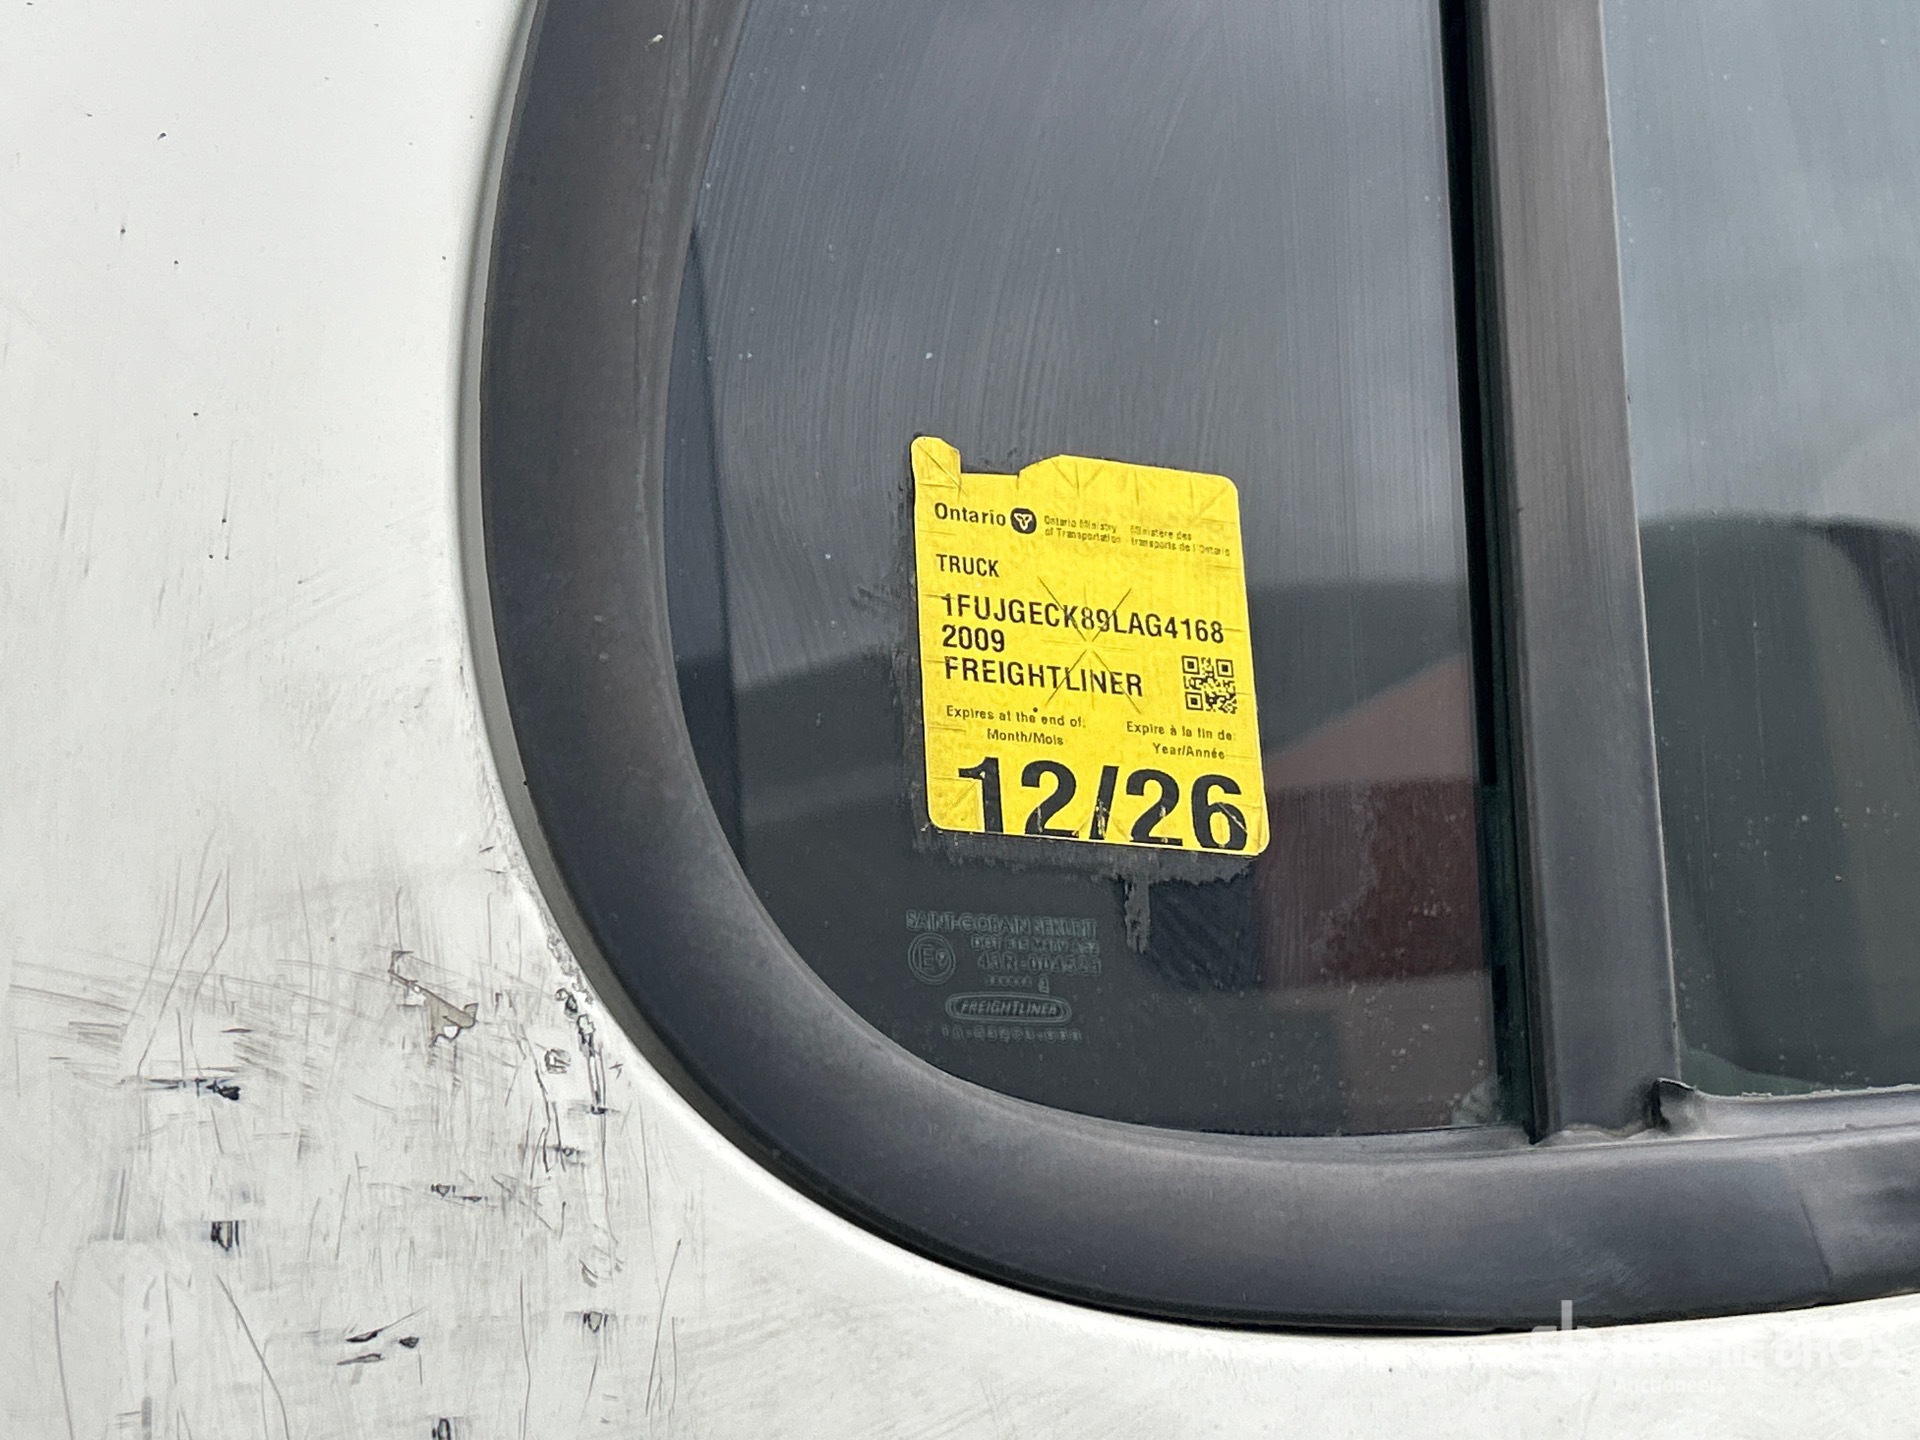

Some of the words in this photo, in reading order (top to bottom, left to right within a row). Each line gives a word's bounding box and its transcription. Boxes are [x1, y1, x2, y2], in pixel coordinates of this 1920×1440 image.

[934, 502, 1006, 526] Ontario
[936, 553, 1000, 578] TRUCK
[940, 593, 1225, 643] 1FUJGECK89LAG4168
[942, 624, 1006, 652] 2009
[944, 656, 1143, 697] FREIGHTLINER
[946, 705, 995, 721] Expires
[999, 709, 1013, 721] at
[1016, 710, 1037, 723] the
[1041, 712, 1065, 727] end
[987, 728, 1064, 746] Month/Mois
[1126, 721, 1166, 738] Expire
[1170, 724, 1178, 737] à
[1181, 725, 1193, 738] la
[1197, 726, 1214, 740] fin
[1152, 742, 1225, 760] Year/Année
[958, 756, 1248, 851] 12/26
